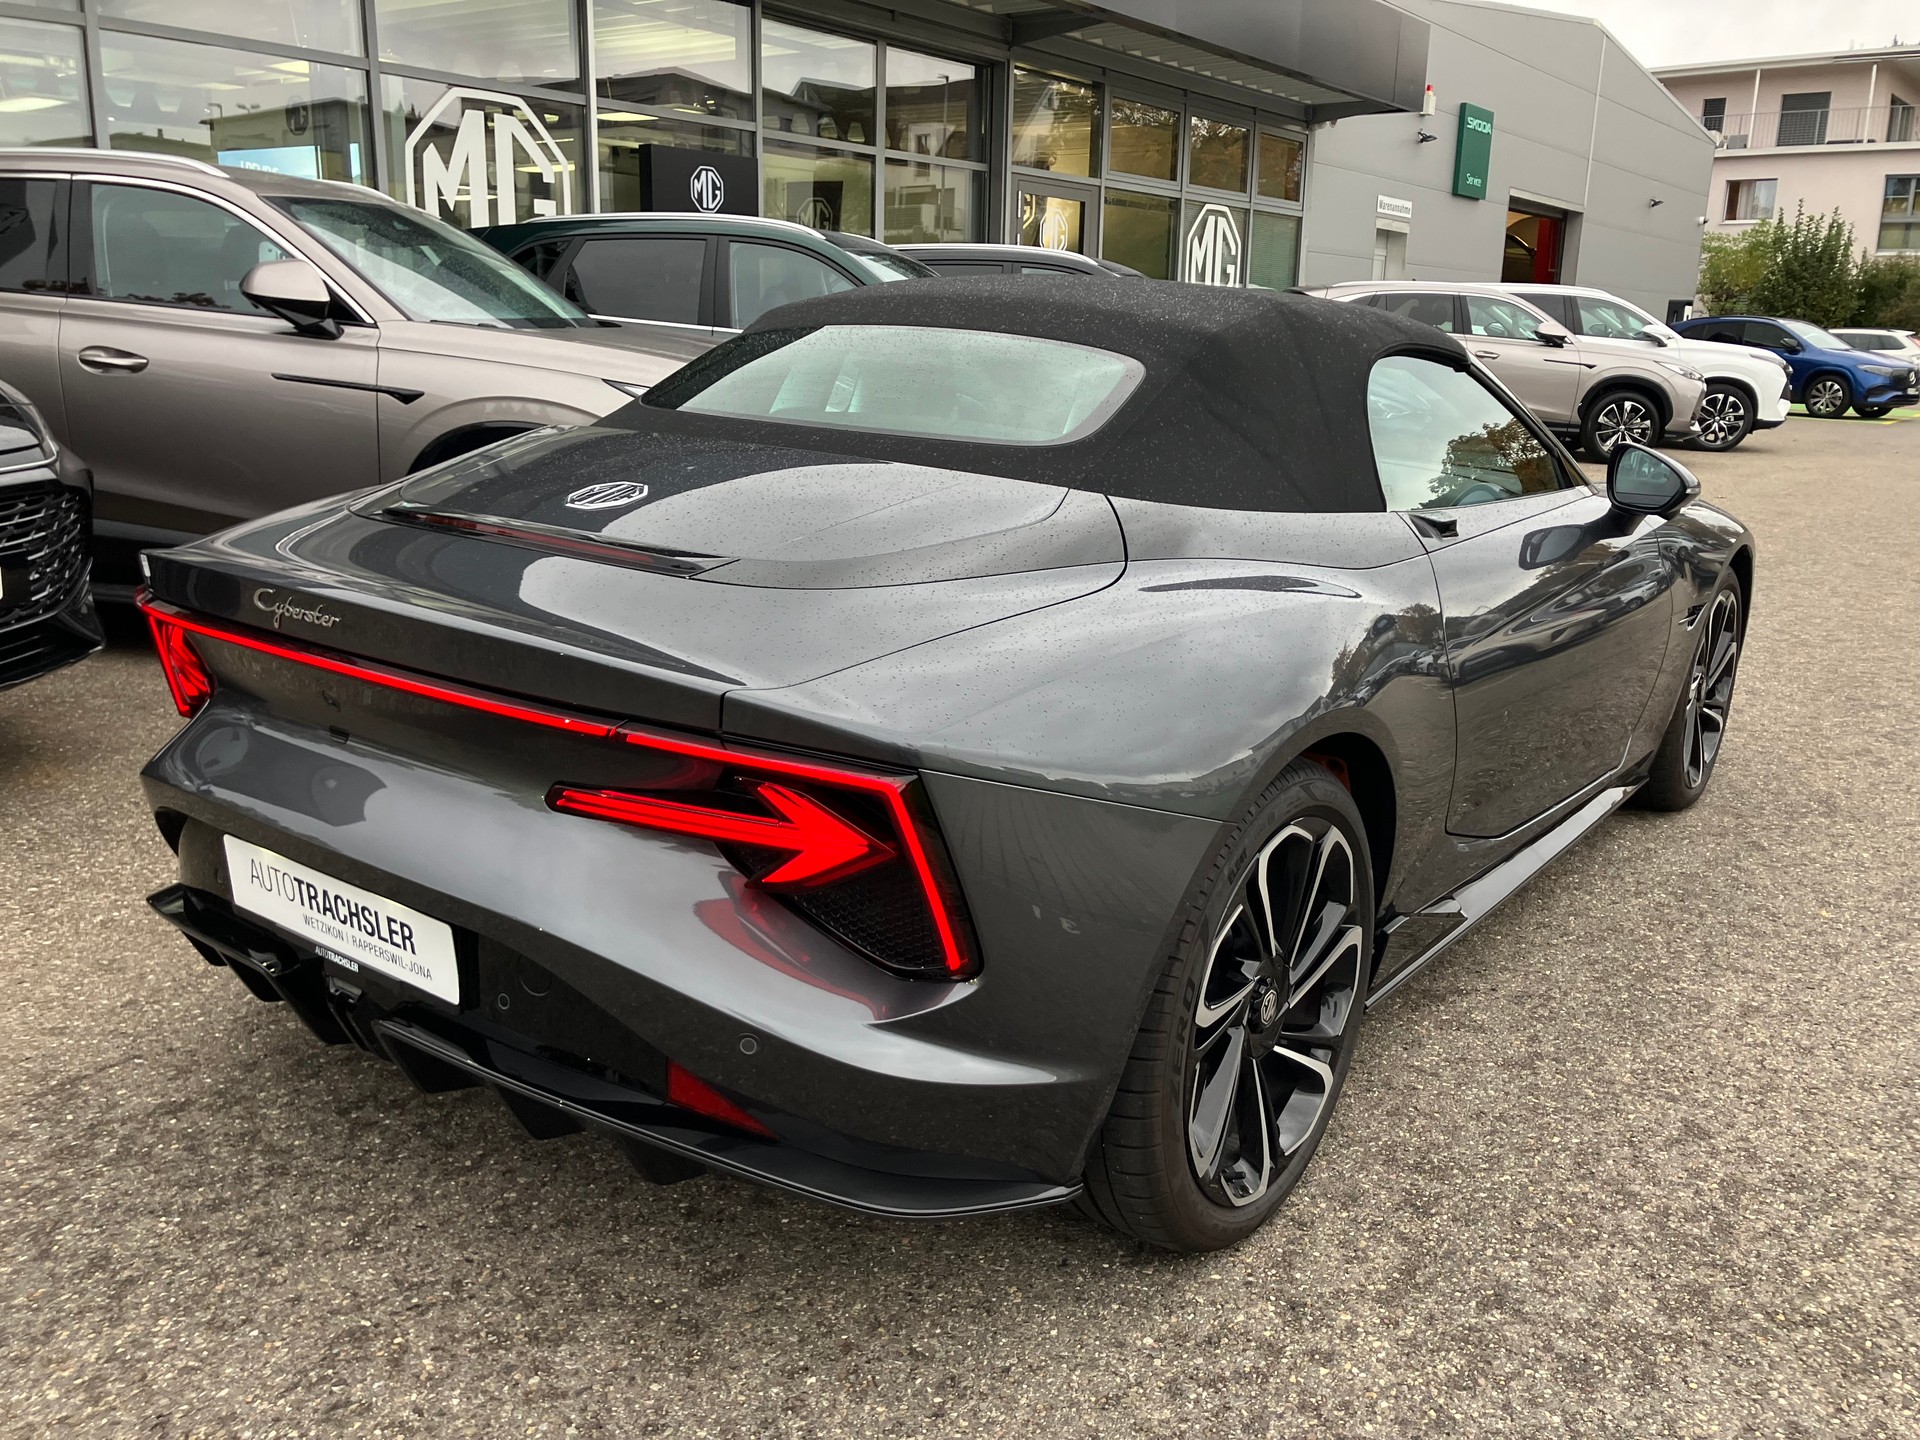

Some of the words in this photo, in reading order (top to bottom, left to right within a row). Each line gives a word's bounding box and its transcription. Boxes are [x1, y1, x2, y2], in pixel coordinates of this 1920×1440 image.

[420, 107, 559, 228] MG
[692, 168, 722, 211] MG
[1465, 173, 1482, 187] Service
[1190, 214, 1238, 287] MG
[253, 588, 341, 629] Cyberster
[250, 858, 417, 955] AUTOTRACHSLER
[303, 914, 344, 945] WETZIKON
[352, 937, 433, 981] RAPPERSWIL-JONA
[315, 945, 359, 973] AUTOTRACHSLER
